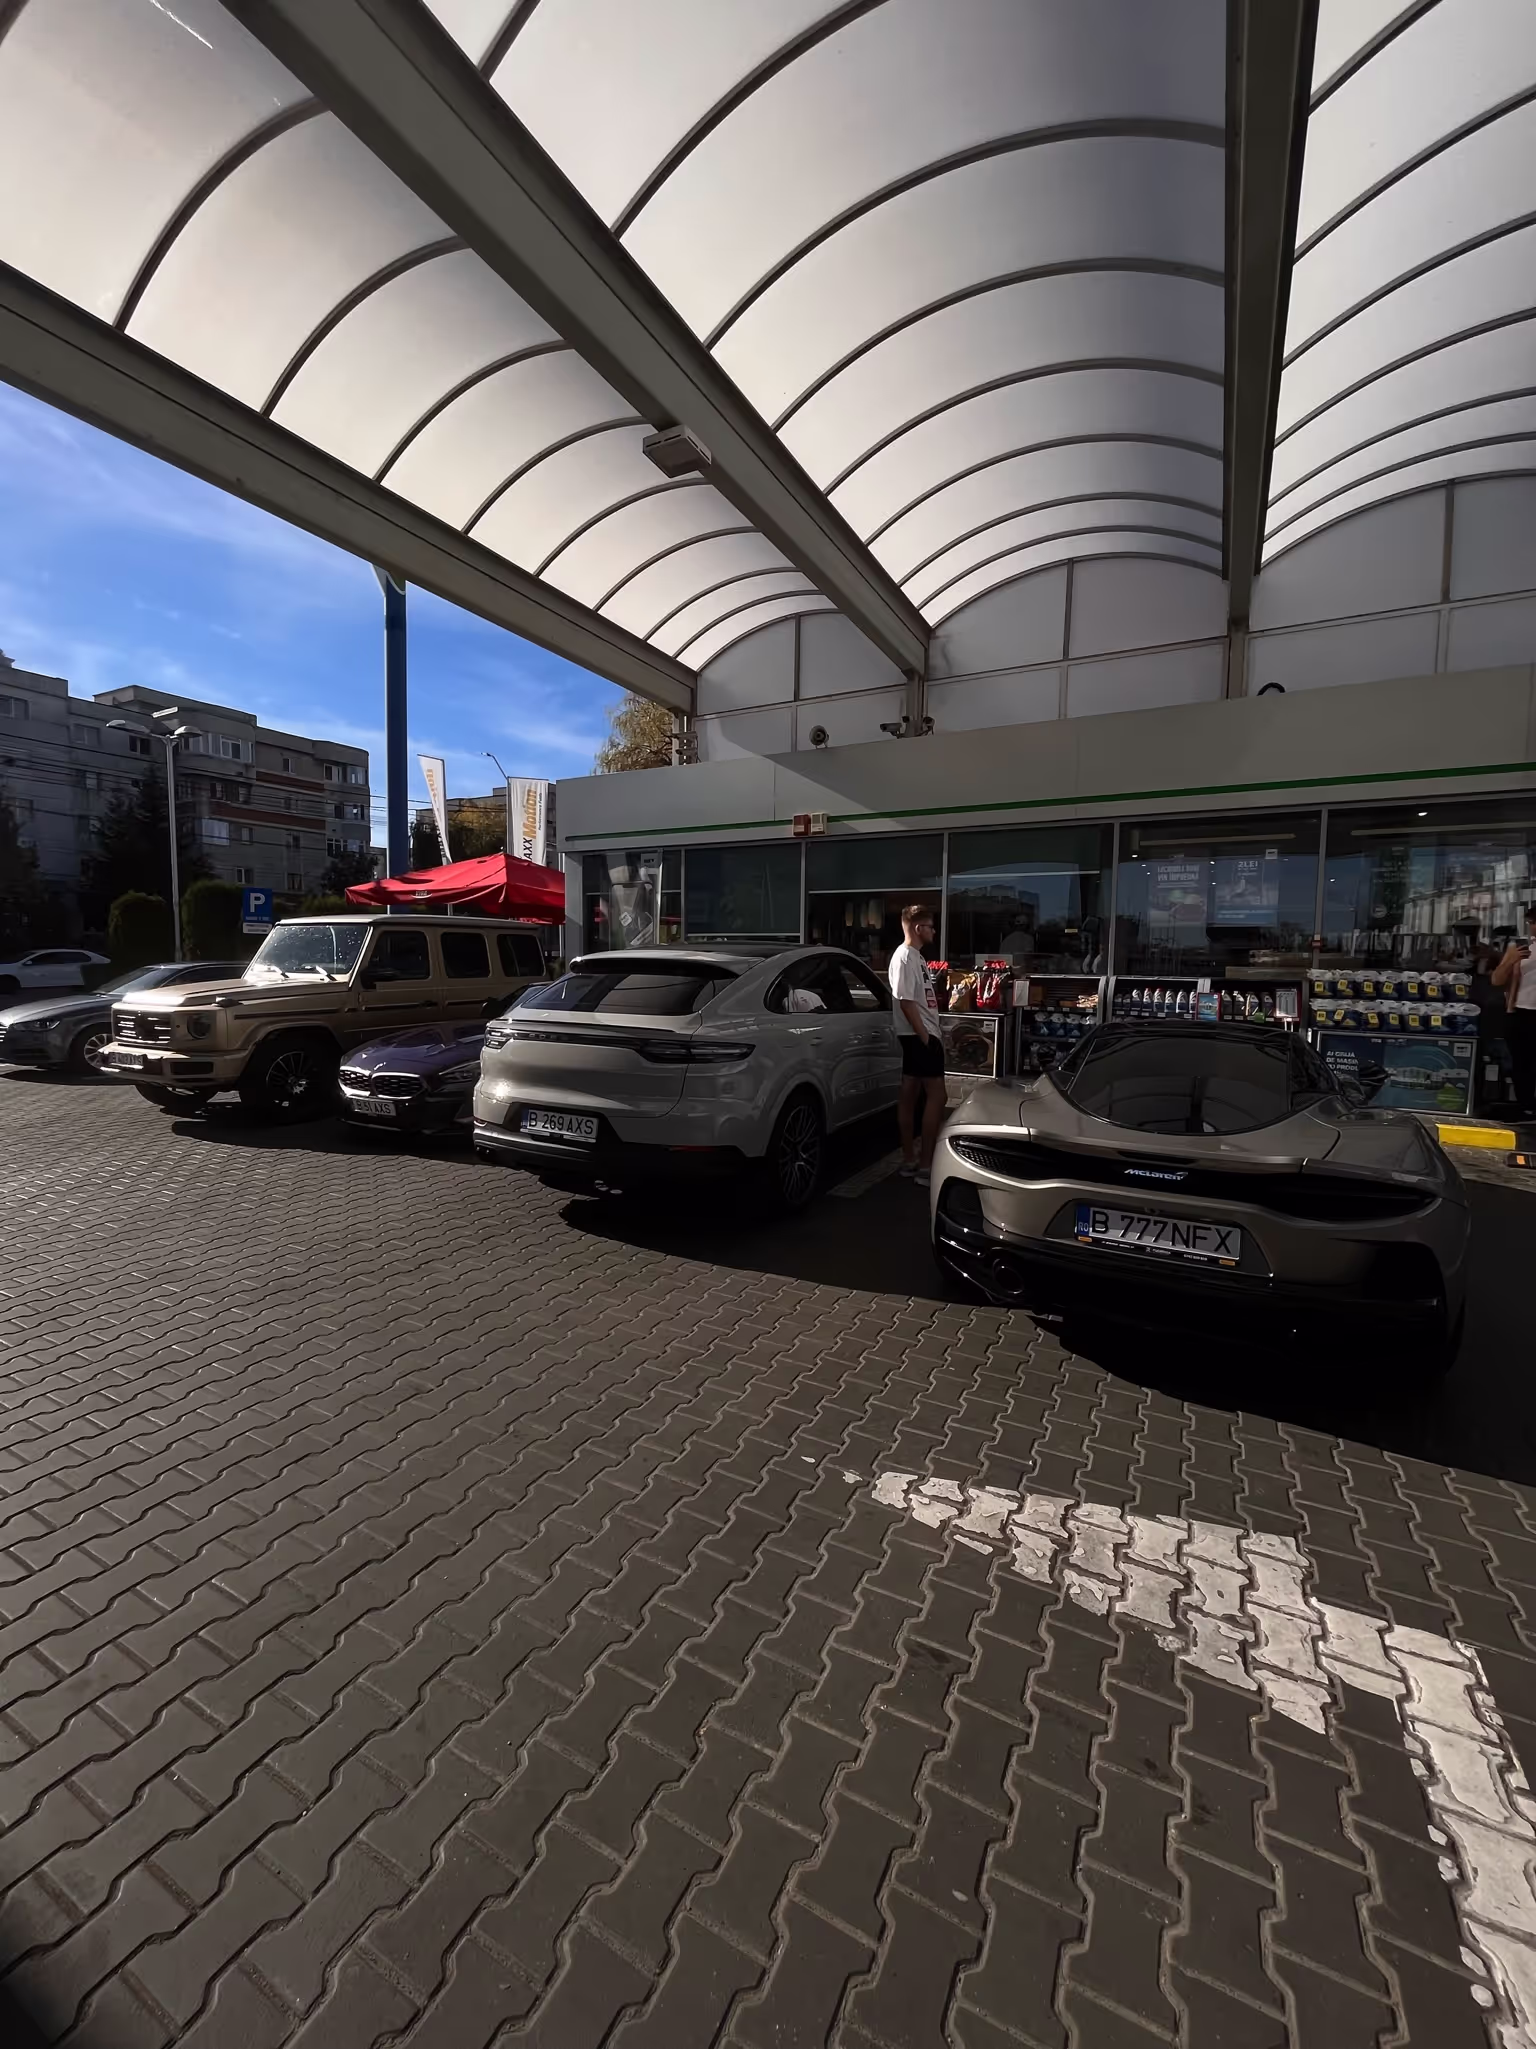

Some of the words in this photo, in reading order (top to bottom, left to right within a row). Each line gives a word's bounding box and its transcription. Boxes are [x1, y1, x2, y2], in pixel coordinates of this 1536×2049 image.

[250, 893, 266, 913] P
[529, 1112, 538, 1127] B
[1091, 1210, 1109, 1234] B
